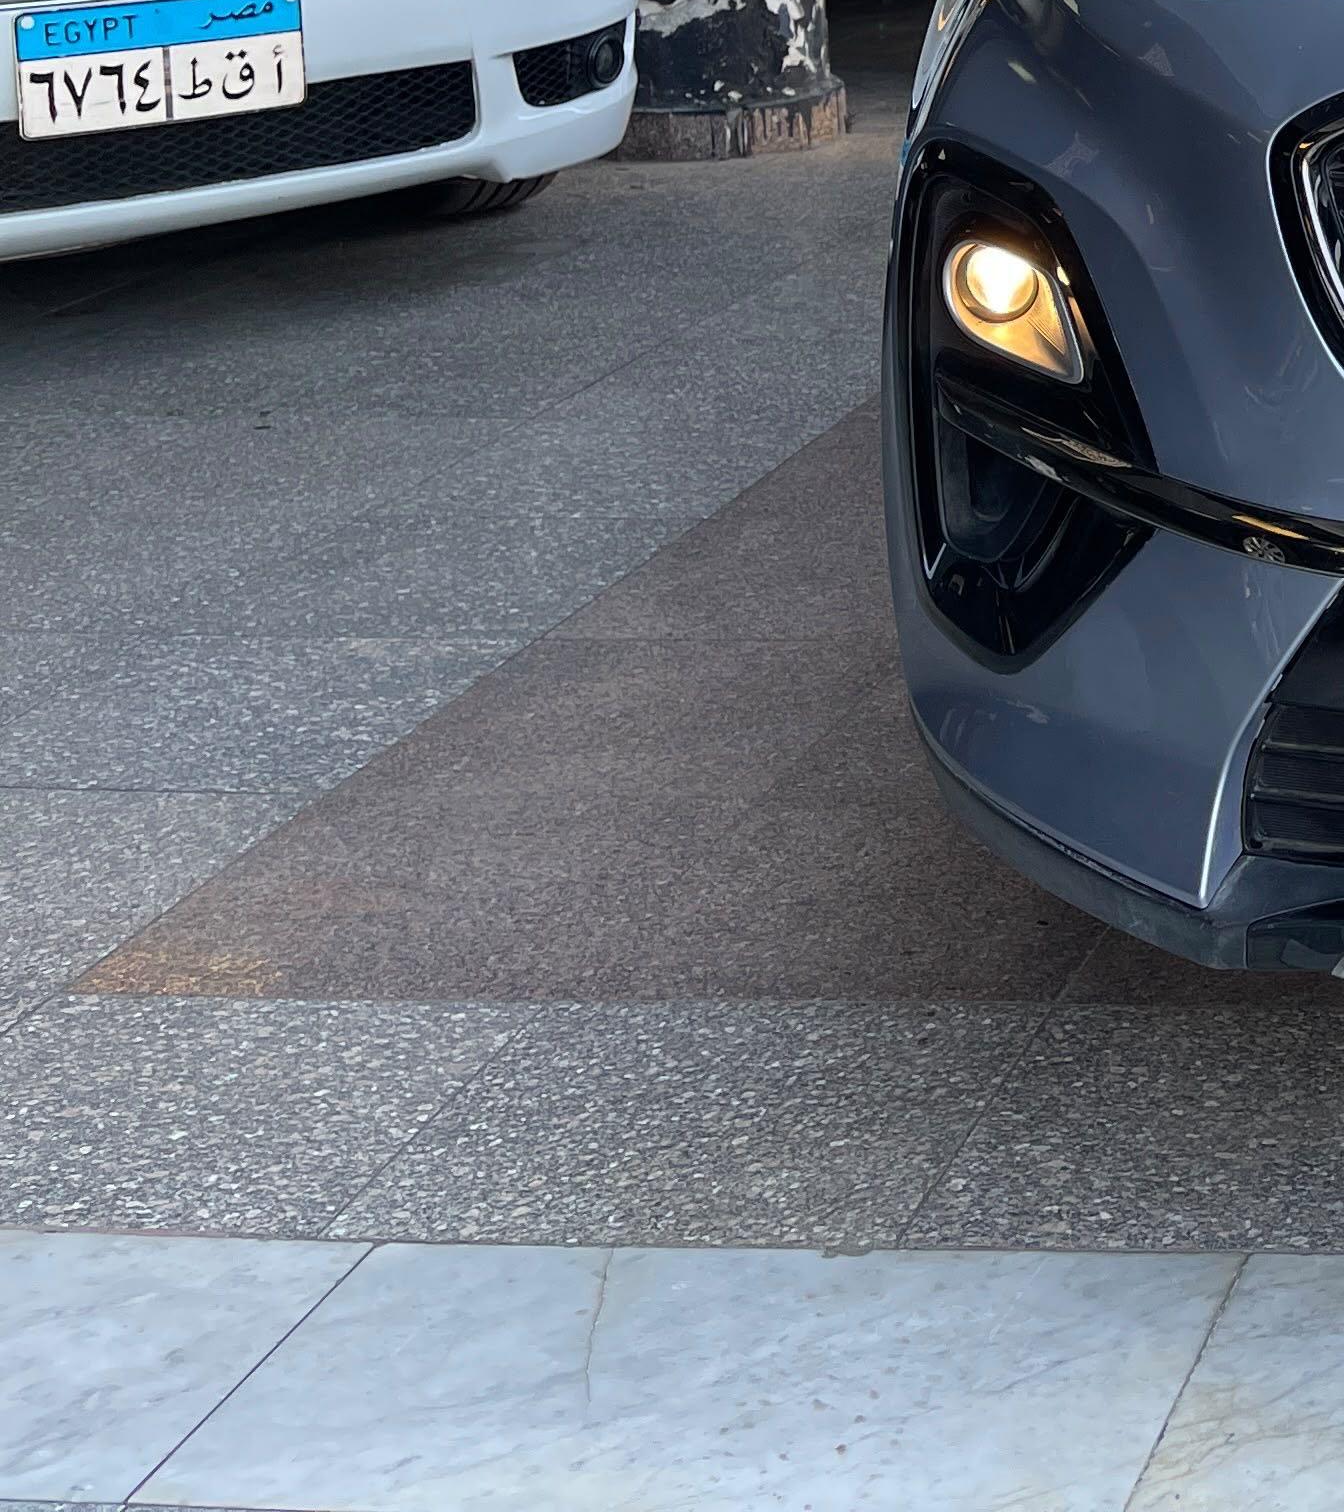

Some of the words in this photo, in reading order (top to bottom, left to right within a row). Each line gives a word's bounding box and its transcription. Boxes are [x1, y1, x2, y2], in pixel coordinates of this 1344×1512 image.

[43, 14, 138, 46] EGYPT
[200, 0, 275, 30] مصر
[29, 58, 162, 124] ٦٧٦٤
